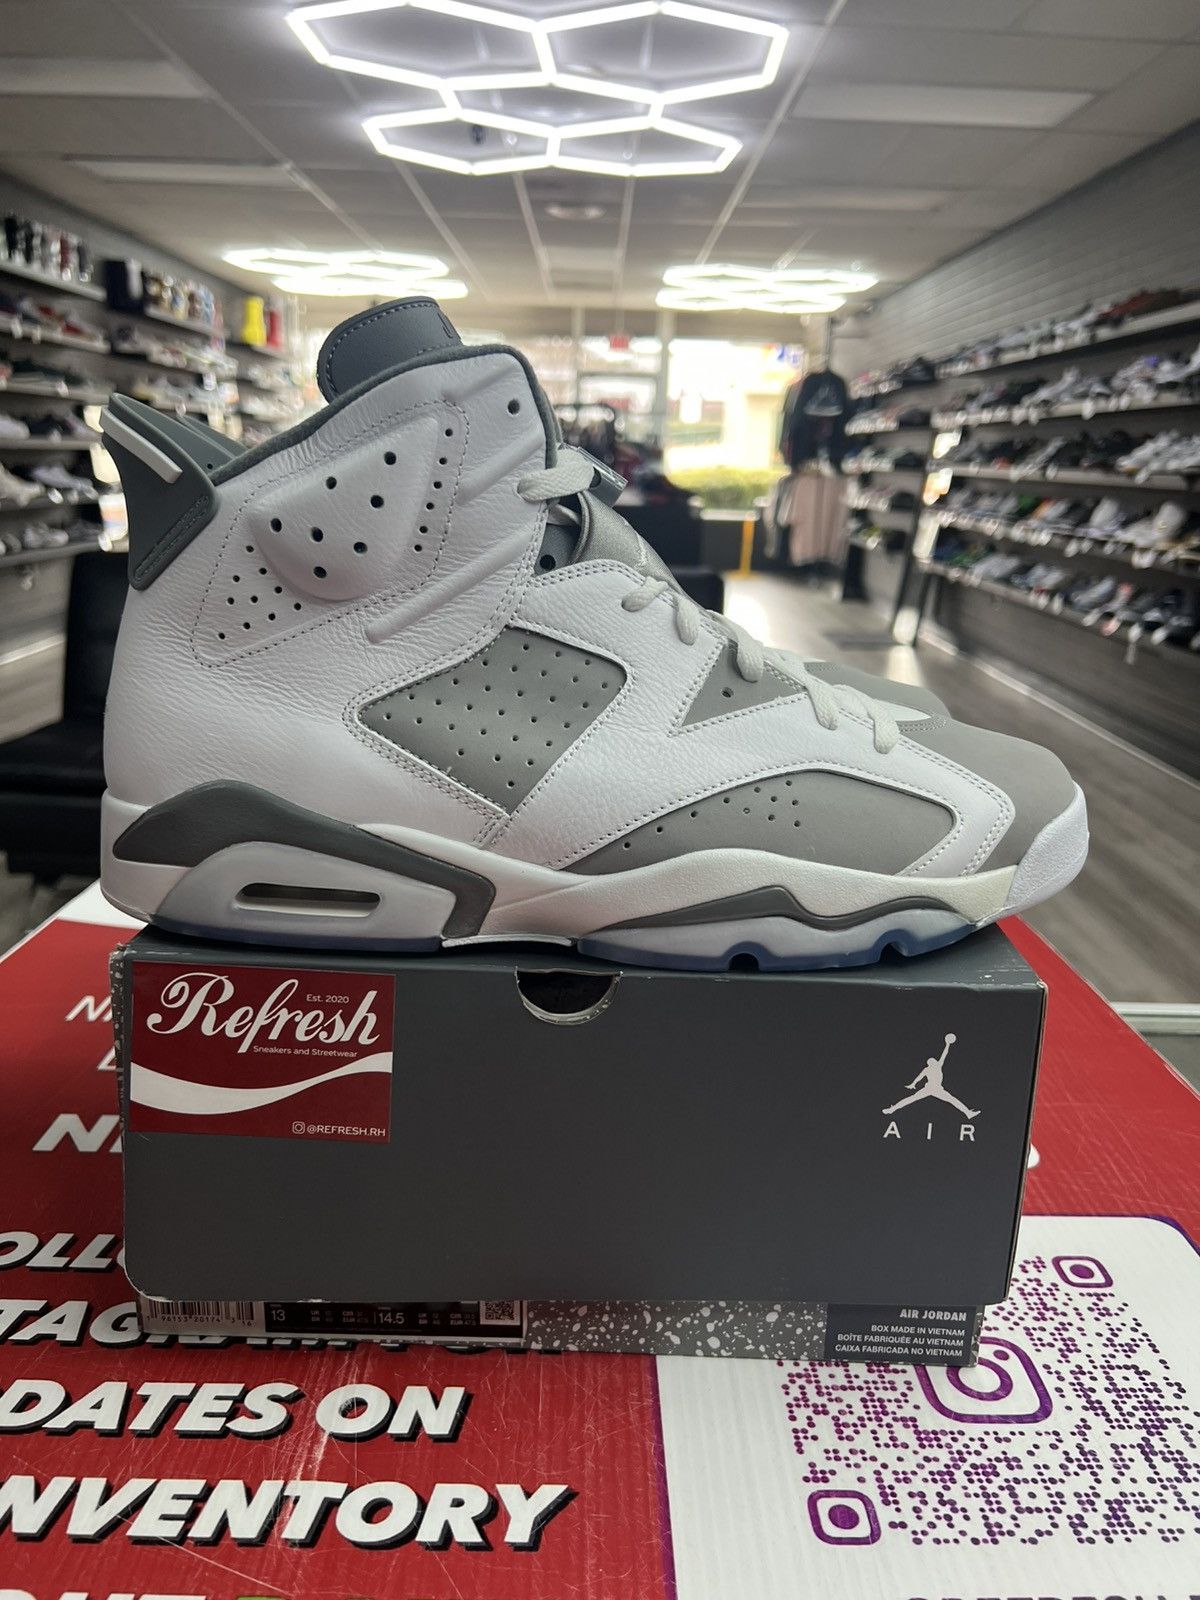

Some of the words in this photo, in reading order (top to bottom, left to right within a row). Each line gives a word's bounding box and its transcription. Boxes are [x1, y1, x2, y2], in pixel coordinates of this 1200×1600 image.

[306, 993, 323, 1003] Est.
[325, 994, 350, 1004] 2020
[146, 972, 381, 1054] Refresh
[253, 1045, 292, 1055] Sneakers
[294, 1046, 310, 1056] and
[311, 1048, 358, 1058] Streetwear
[307, 1123, 386, 1137] @REFRESH.RH
[0, 1231, 125, 1269] OLL
[270, 1309, 286, 1321] 13
[378, 1312, 405, 1324] 14.5
[900, 1308, 919, 1319] AIR
[922, 1310, 967, 1321] JORDAN
[871, 1324, 889, 1333] BOX
[891, 1325, 915, 1334] MADE
[917, 1326, 926, 1334] IN
[928, 1327, 965, 1337] VIETNAM
[837, 1333, 862, 1342] BOÎTE
[864, 1334, 911, 1344] FABRIQUÉE
[926, 1337, 964, 1347] VIETNAM
[835, 1344, 860, 1352] CAIXA
[862, 1345, 910, 1354] FABRICADA
[911, 1346, 924, 1355] NO
[925, 1347, 963, 1357] VIETNAM
[315, 1383, 466, 1440] ON
